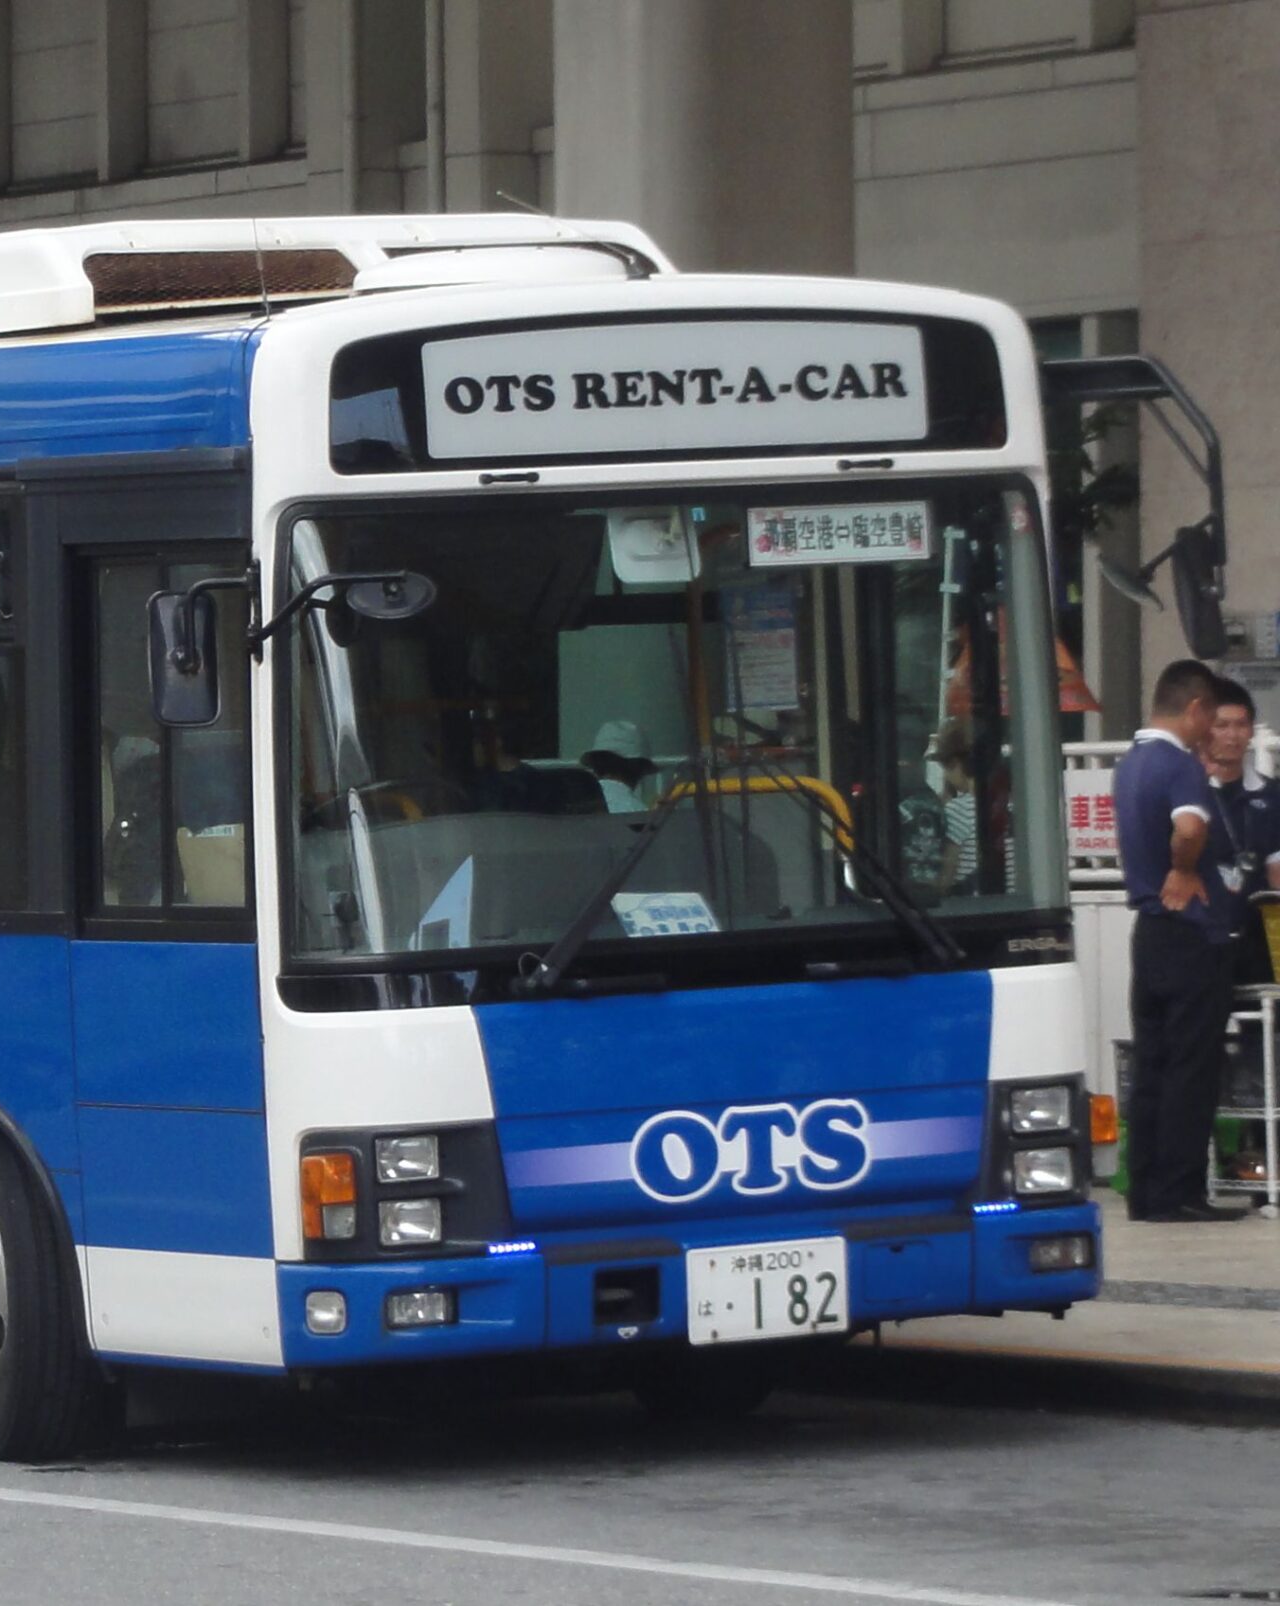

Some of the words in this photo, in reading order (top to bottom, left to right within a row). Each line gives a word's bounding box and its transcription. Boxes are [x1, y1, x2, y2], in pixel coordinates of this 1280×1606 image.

[444, 373, 555, 415] OTS
[572, 362, 908, 409] RENT-A-CAR
[629, 1098, 871, 1203] OTS
[730, 1250, 802, 1273] 沖縄200
